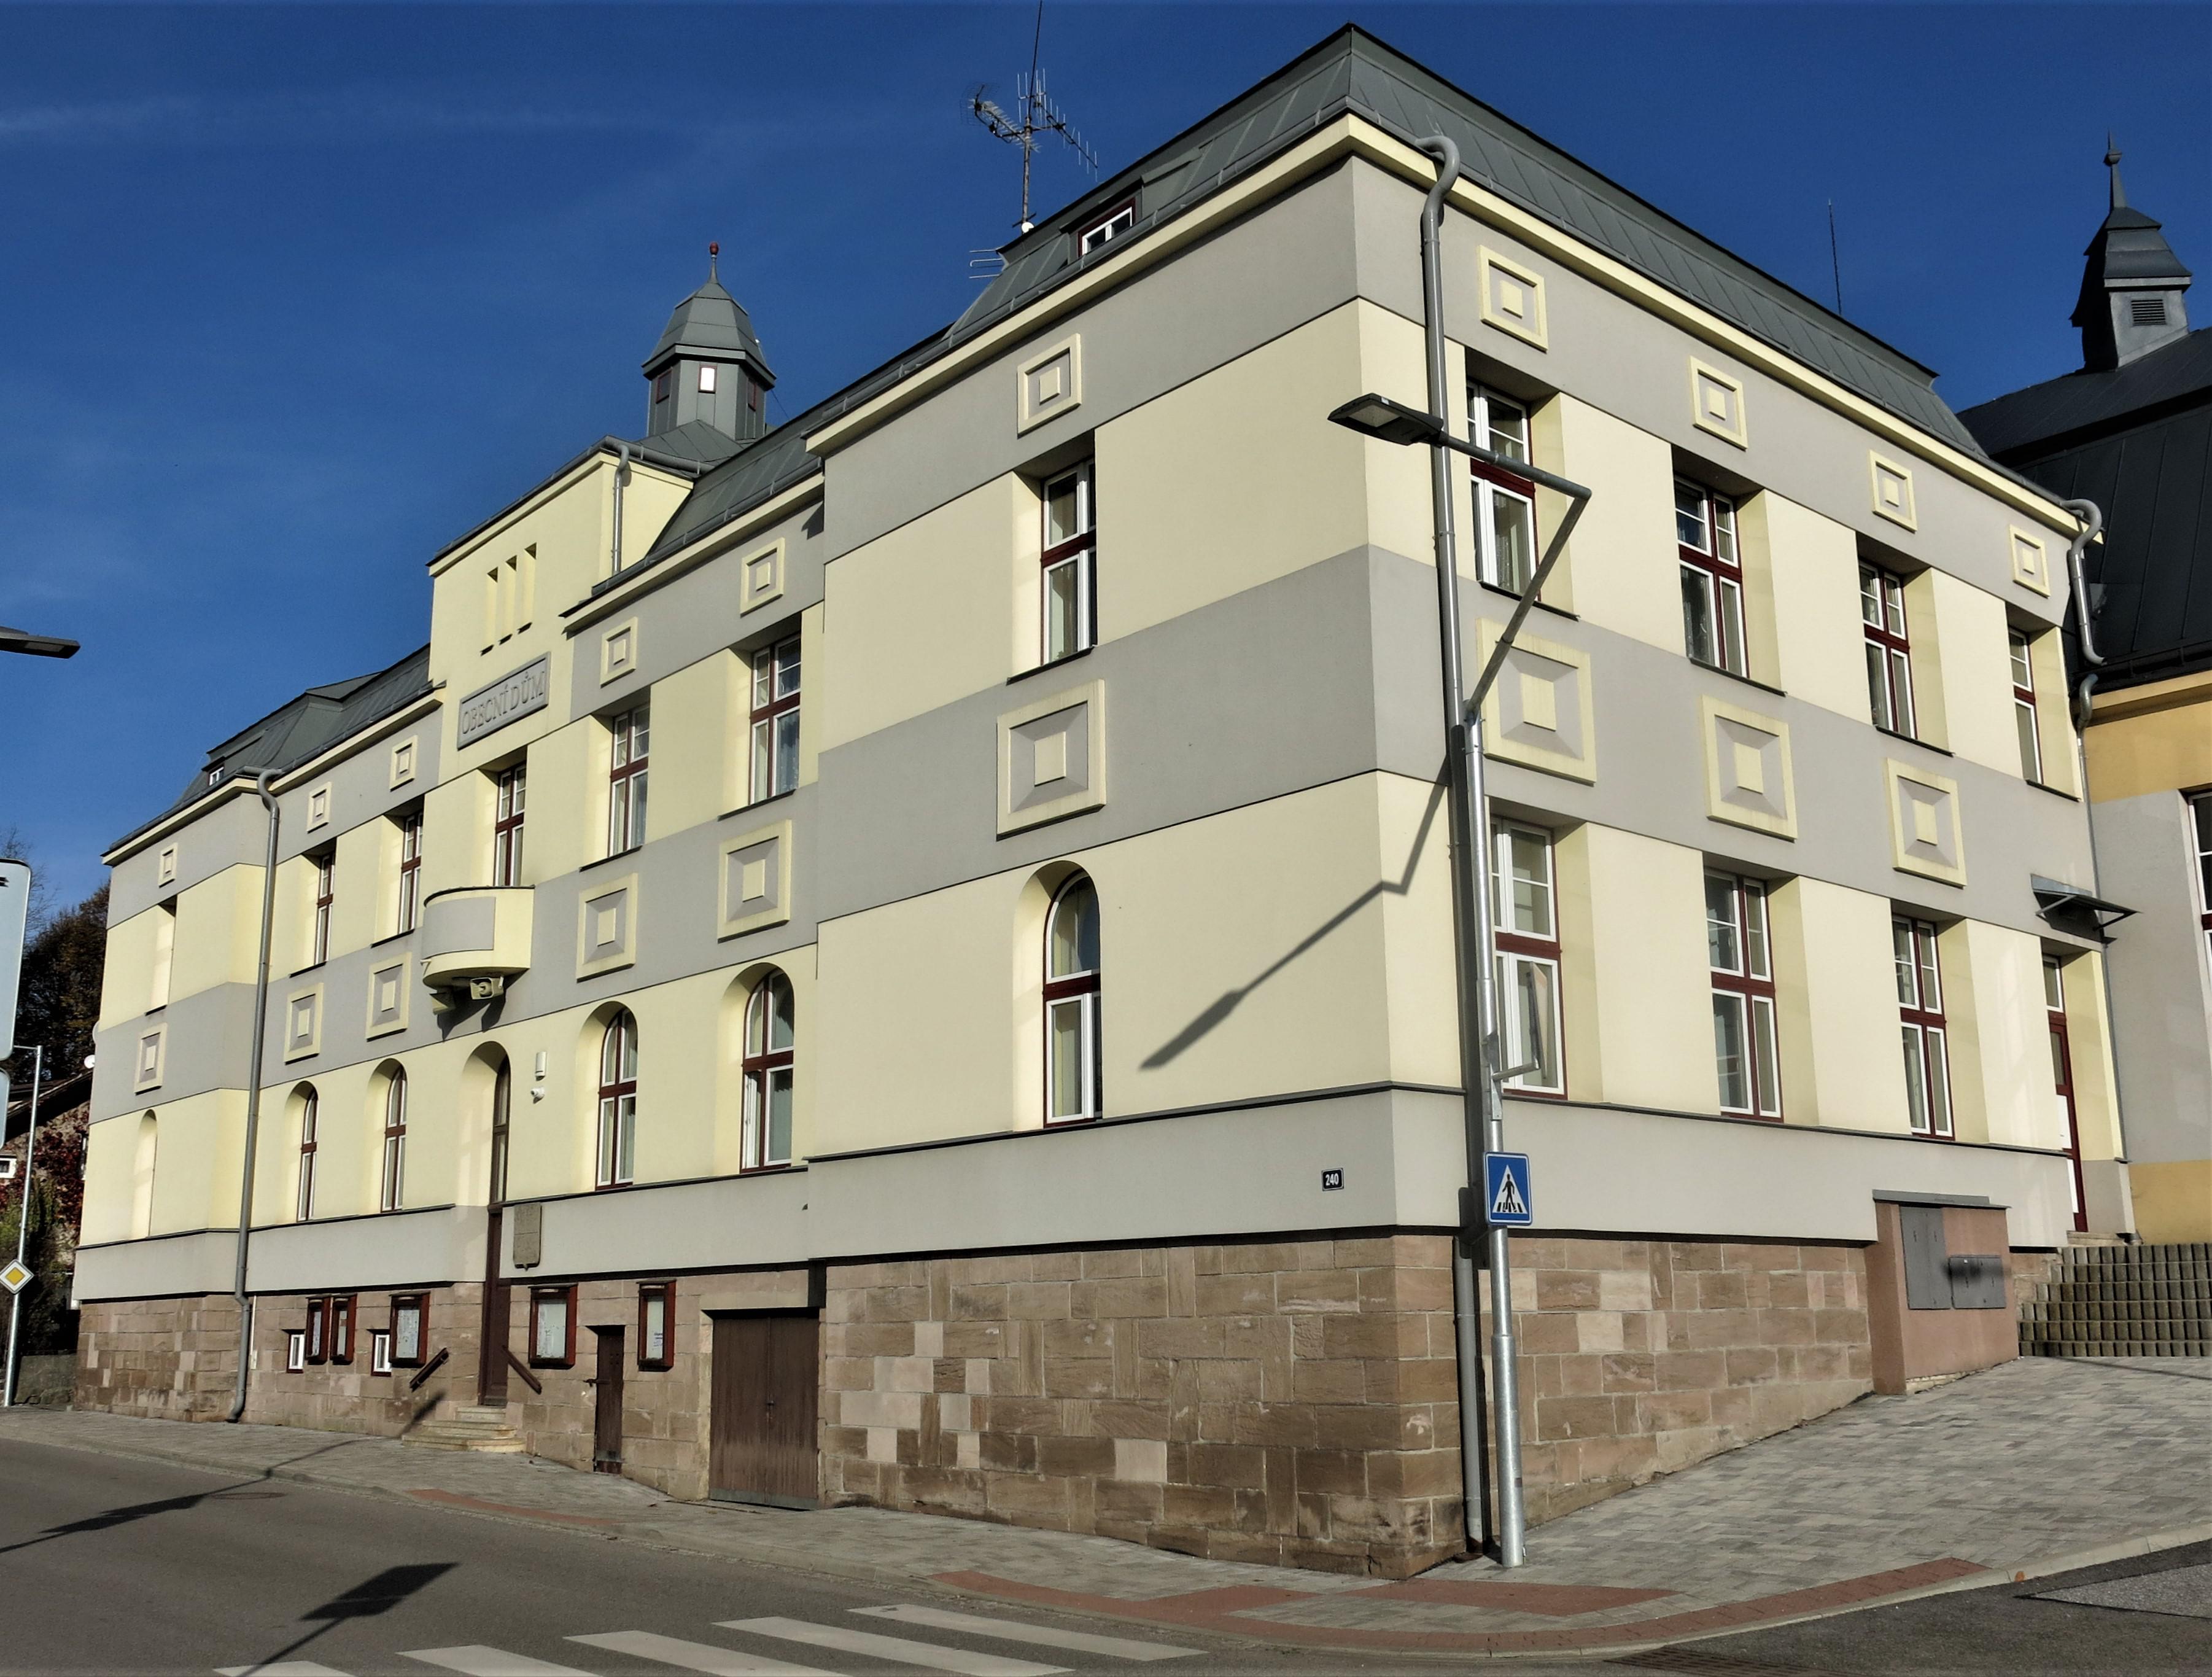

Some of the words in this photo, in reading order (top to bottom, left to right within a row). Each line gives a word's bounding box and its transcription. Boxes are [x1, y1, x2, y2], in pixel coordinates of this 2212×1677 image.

[462, 684, 508, 734] OBECNÍ
[510, 671, 546, 710] DŮM
[1325, 1173, 1339, 1186] 240
